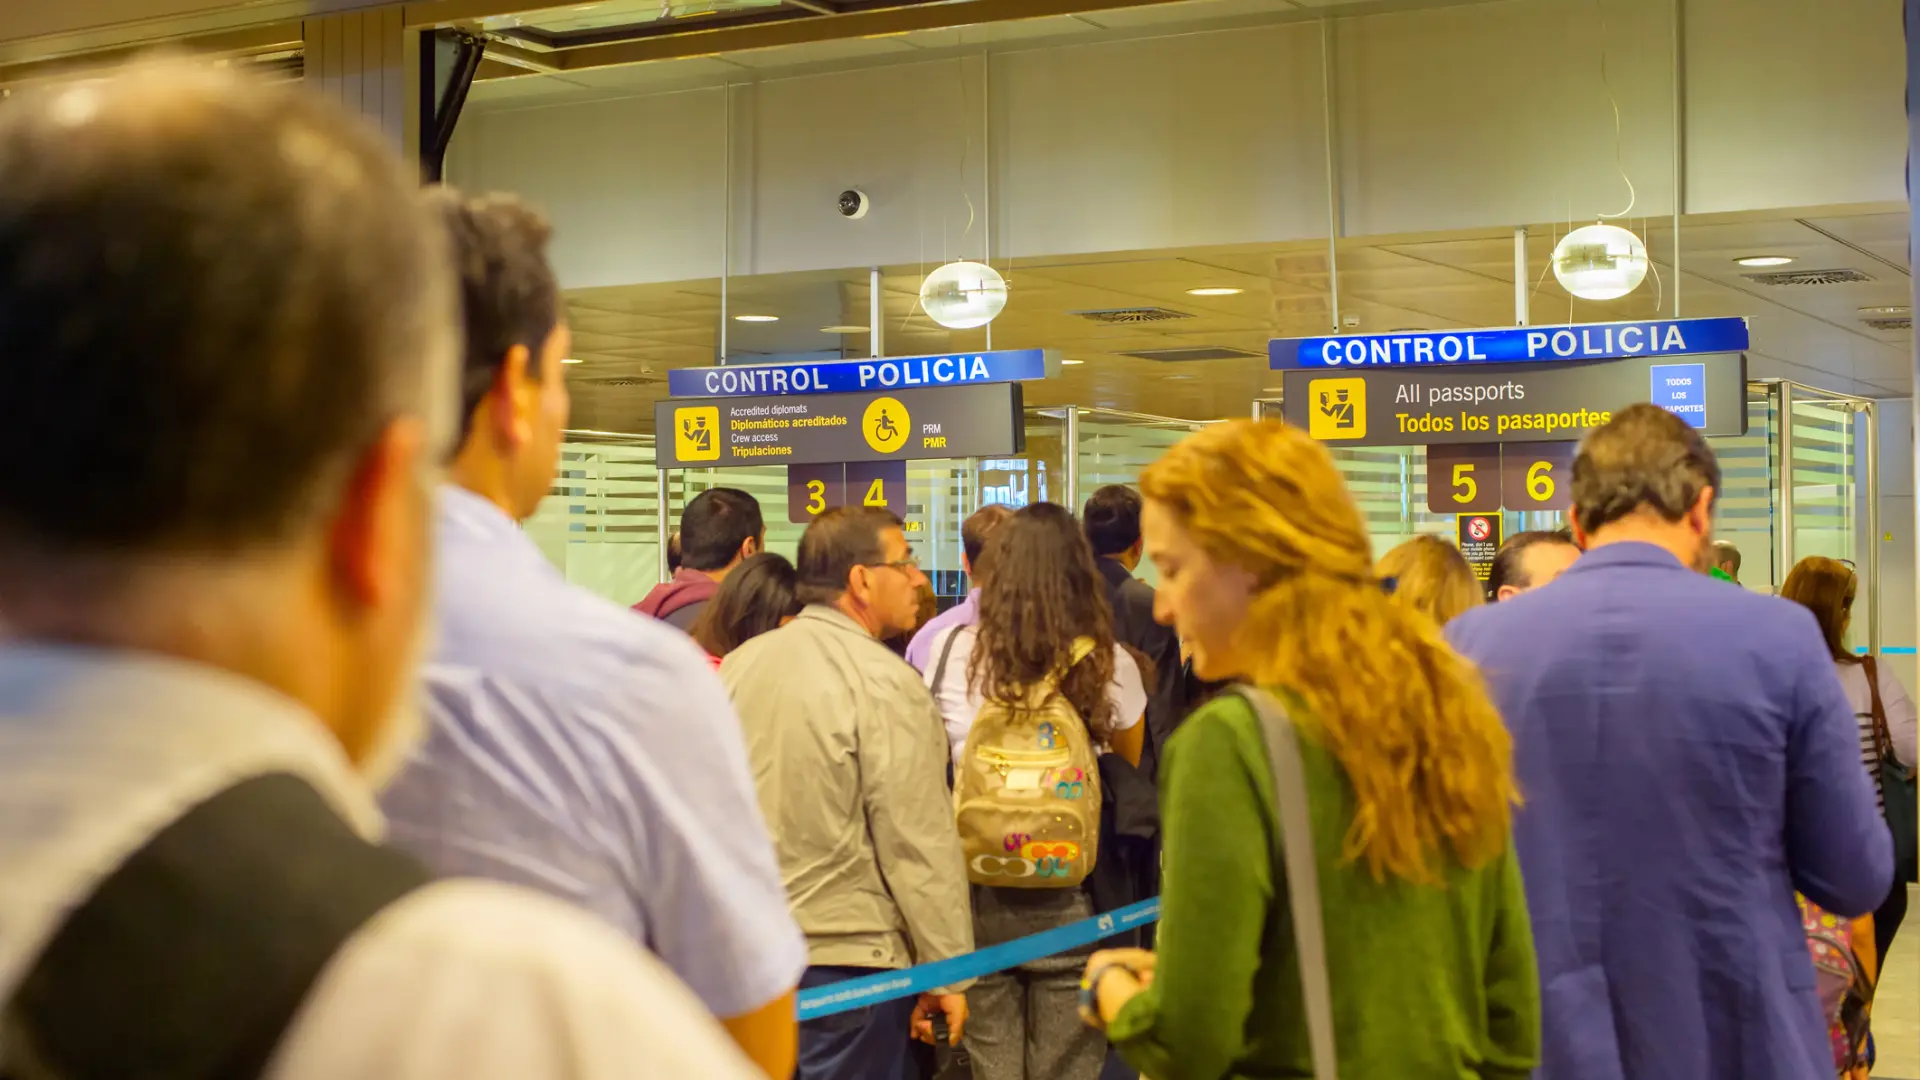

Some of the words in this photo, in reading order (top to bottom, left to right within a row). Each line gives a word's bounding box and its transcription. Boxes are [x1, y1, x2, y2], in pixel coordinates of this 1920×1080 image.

[1321, 335, 1487, 366] CONTROL
[1526, 325, 1688, 358] POLICIA
[704, 367, 829, 394] CONTROL
[858, 356, 990, 388] POLICIA
[1665, 377, 1692, 386] TODOS
[1395, 384, 1420, 404] All
[1429, 381, 1525, 406] passports
[1671, 391, 1687, 400] LOS
[730, 405, 770, 417] Accredited
[771, 404, 808, 416] diplomats
[730, 418, 790, 432] Diplomáticos
[792, 415, 848, 428] acreditados
[1395, 412, 1454, 433] Todos
[1461, 411, 1490, 431] los
[1497, 407, 1611, 434] pasaportes
[922, 423, 941, 434] PRM
[731, 433, 750, 443] Crew
[751, 433, 779, 443] access
[923, 437, 947, 449] PMR
[731, 445, 793, 458] Tripulaciones
[1451, 463, 1478, 504] 5
[1525, 460, 1556, 502] 6
[805, 479, 826, 515] 3
[863, 478, 888, 507] 4
